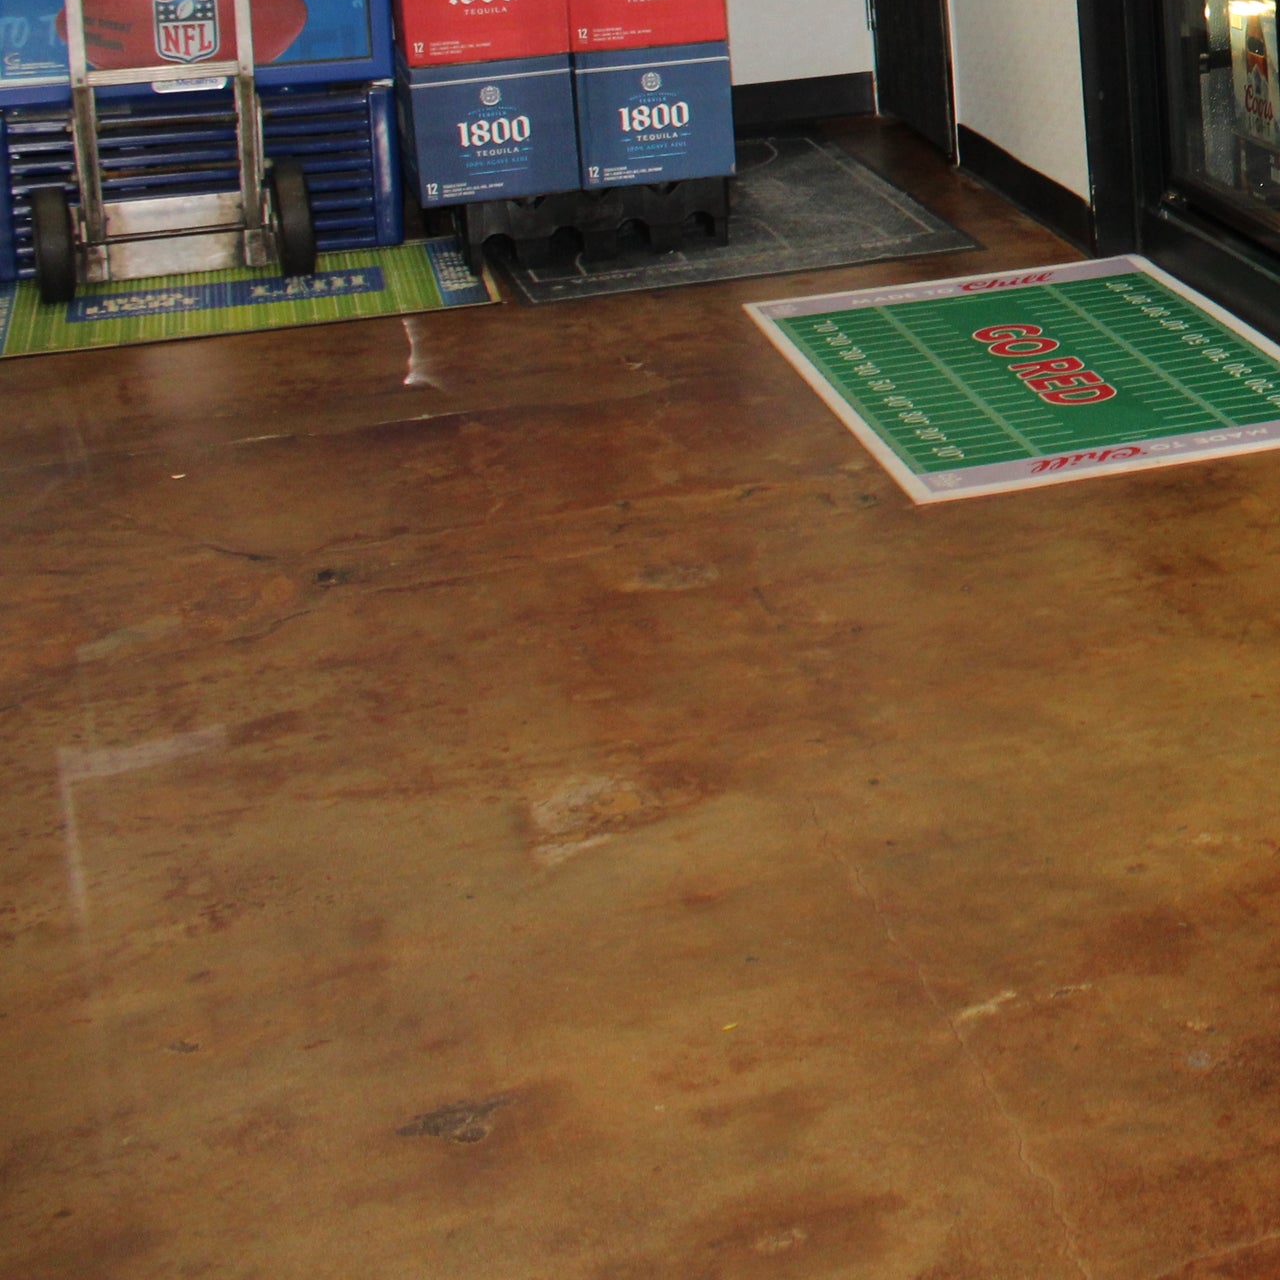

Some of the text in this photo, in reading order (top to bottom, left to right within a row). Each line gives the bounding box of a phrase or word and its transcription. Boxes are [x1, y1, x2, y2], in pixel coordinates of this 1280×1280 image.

[162, 23, 212, 56] NFL
[619, 100, 690, 132] 1800
[1243, 82, 1274, 121] Coors
[457, 115, 531, 147] 1800
[476, 147, 519, 157] TEQUILA
[852, 272, 1053, 306] MADE TO Chill
[972, 323, 1060, 357] GO
[1007, 356, 1117, 406] RED
